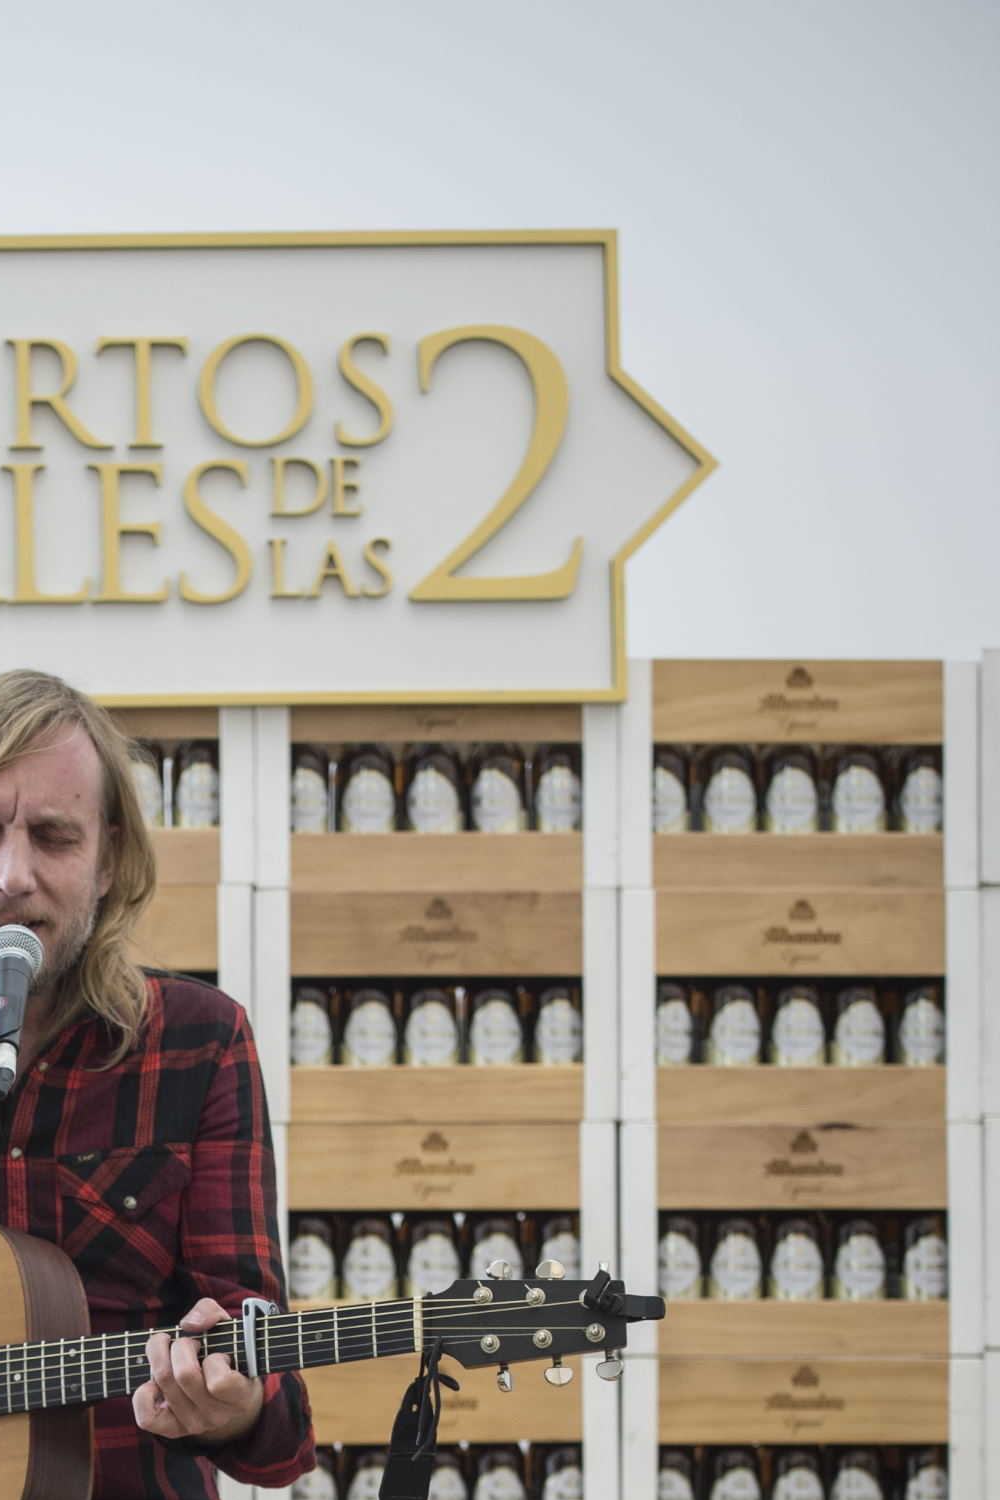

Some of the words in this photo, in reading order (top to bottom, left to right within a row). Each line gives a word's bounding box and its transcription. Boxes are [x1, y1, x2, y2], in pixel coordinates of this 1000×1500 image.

[270, 456, 362, 518] DE
[408, 324, 585, 602] 2
[269, 538, 393, 600] LAS
